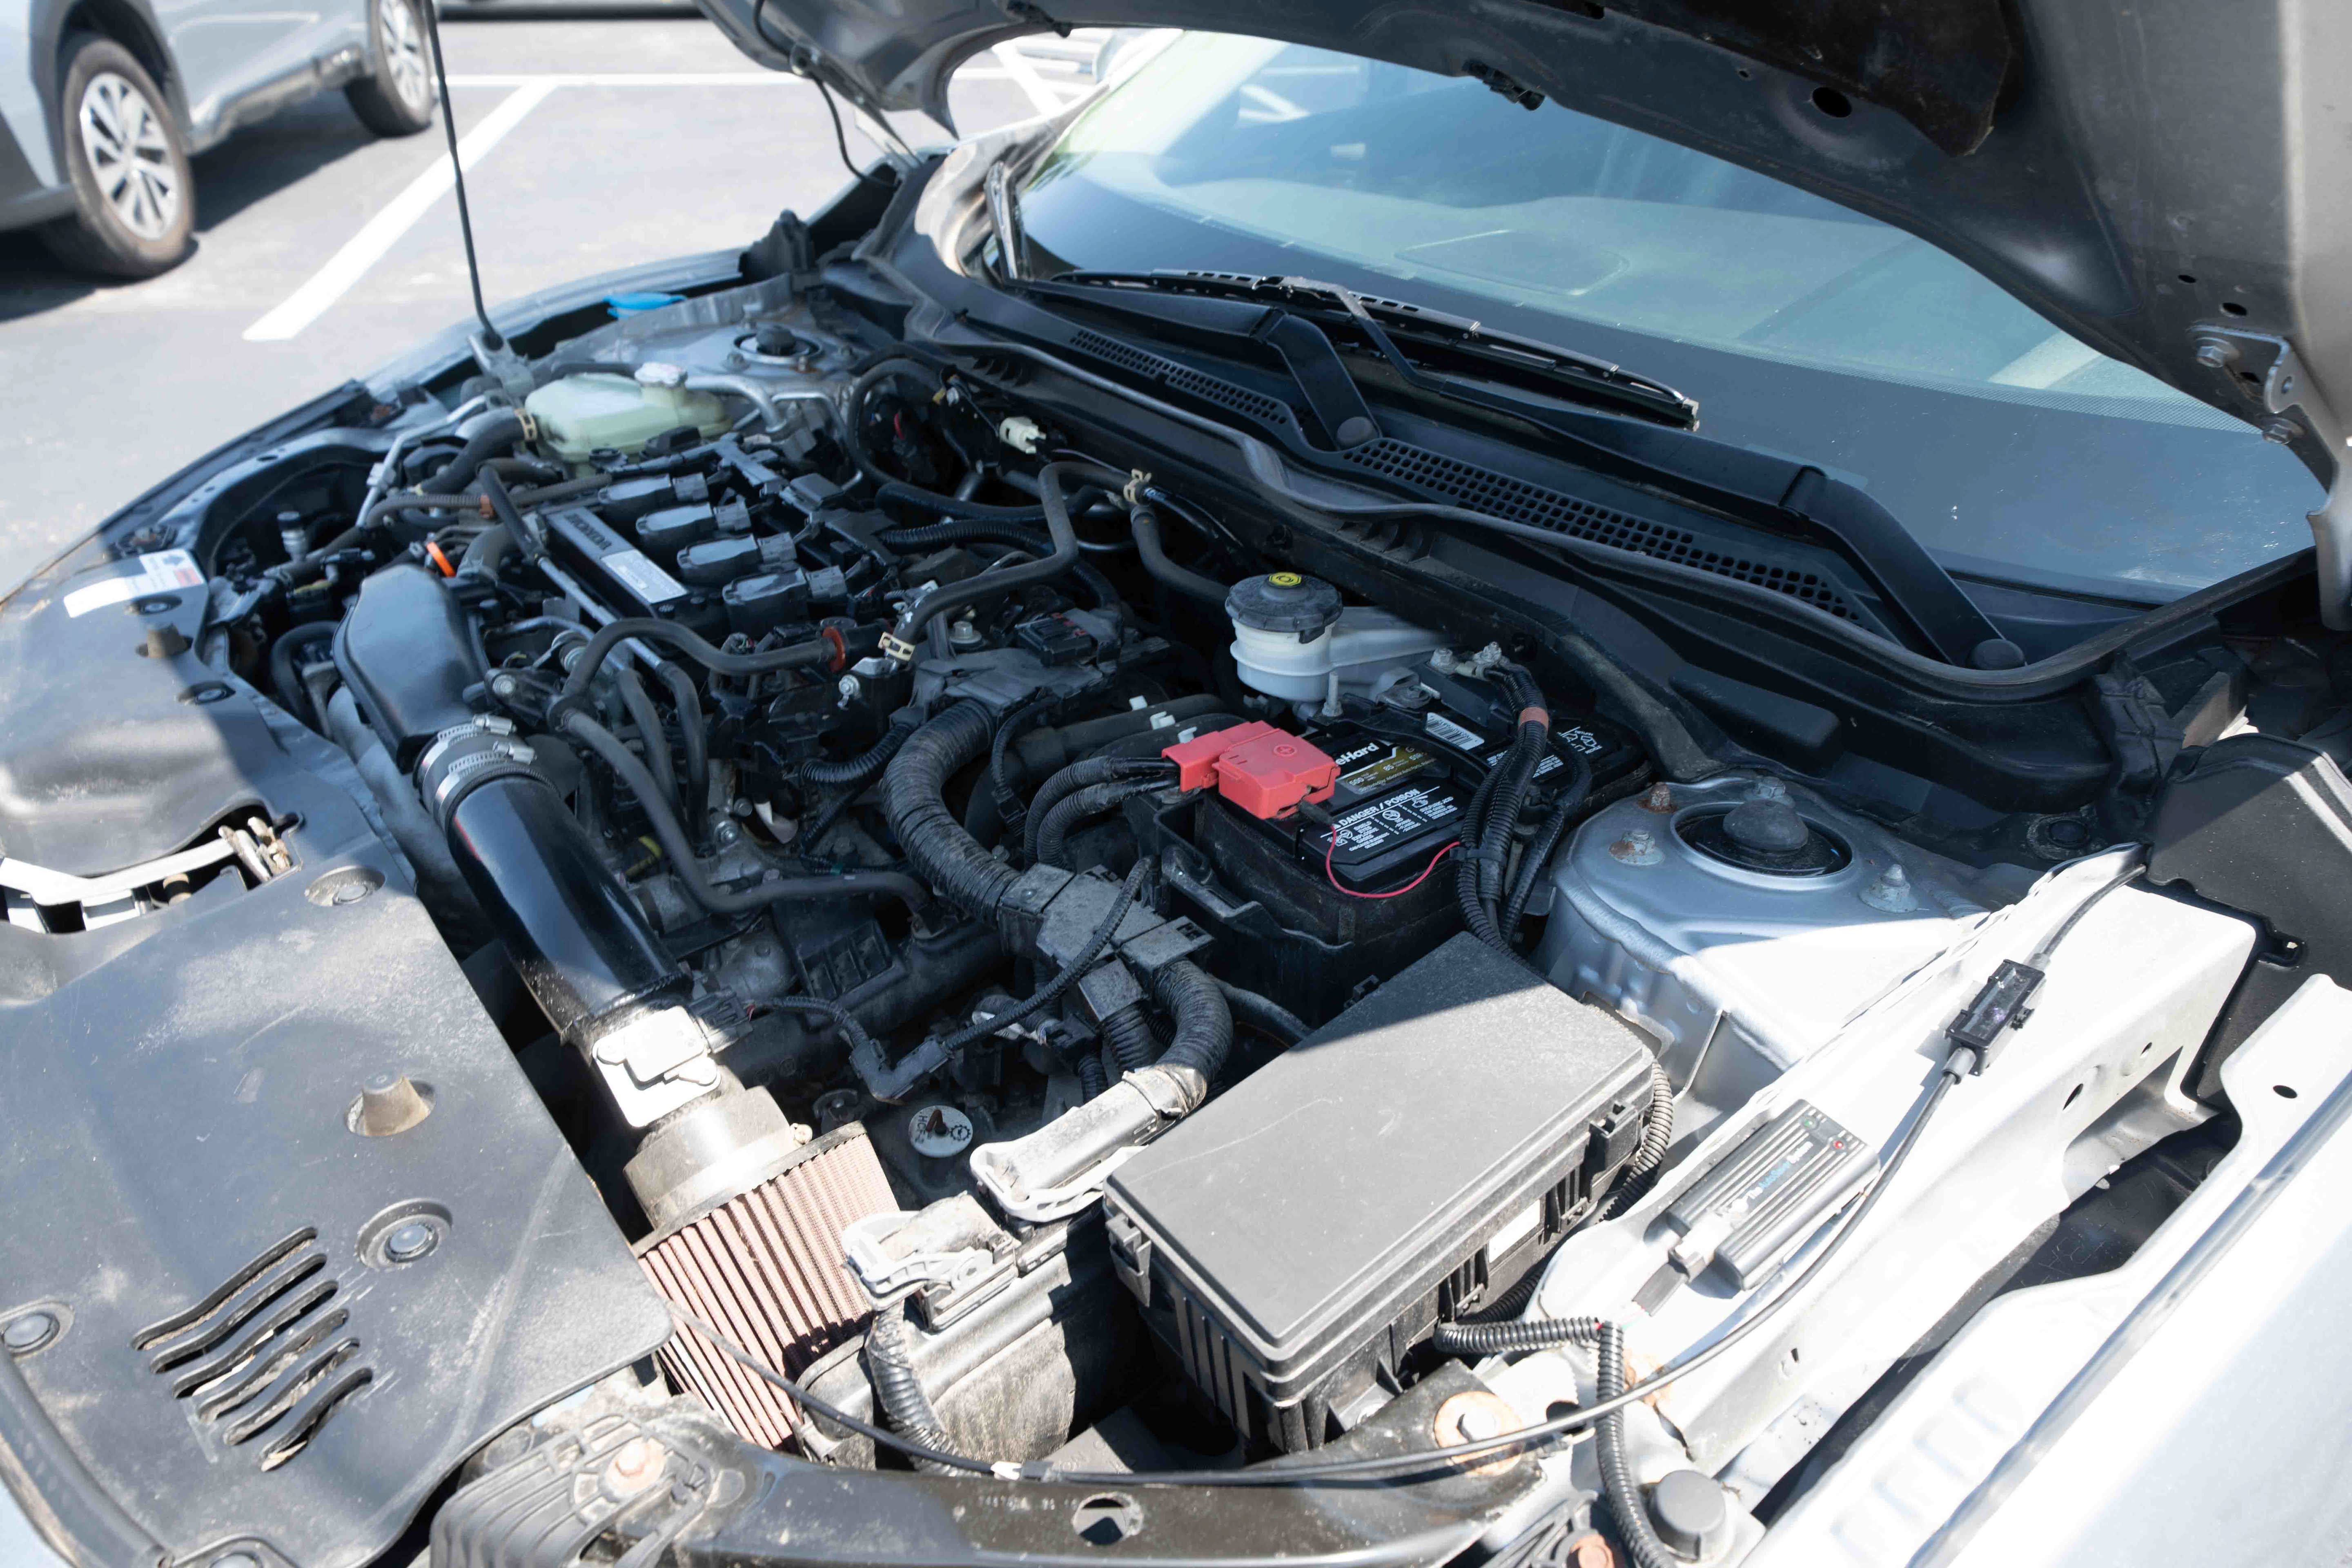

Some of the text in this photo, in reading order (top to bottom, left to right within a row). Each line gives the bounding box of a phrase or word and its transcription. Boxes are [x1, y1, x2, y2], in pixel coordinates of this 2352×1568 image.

[565, 512, 612, 550] HONDA
[1335, 742, 1380, 765] eHard
[1339, 806, 1379, 826] DANGER
[1383, 788, 1421, 806] POISON
